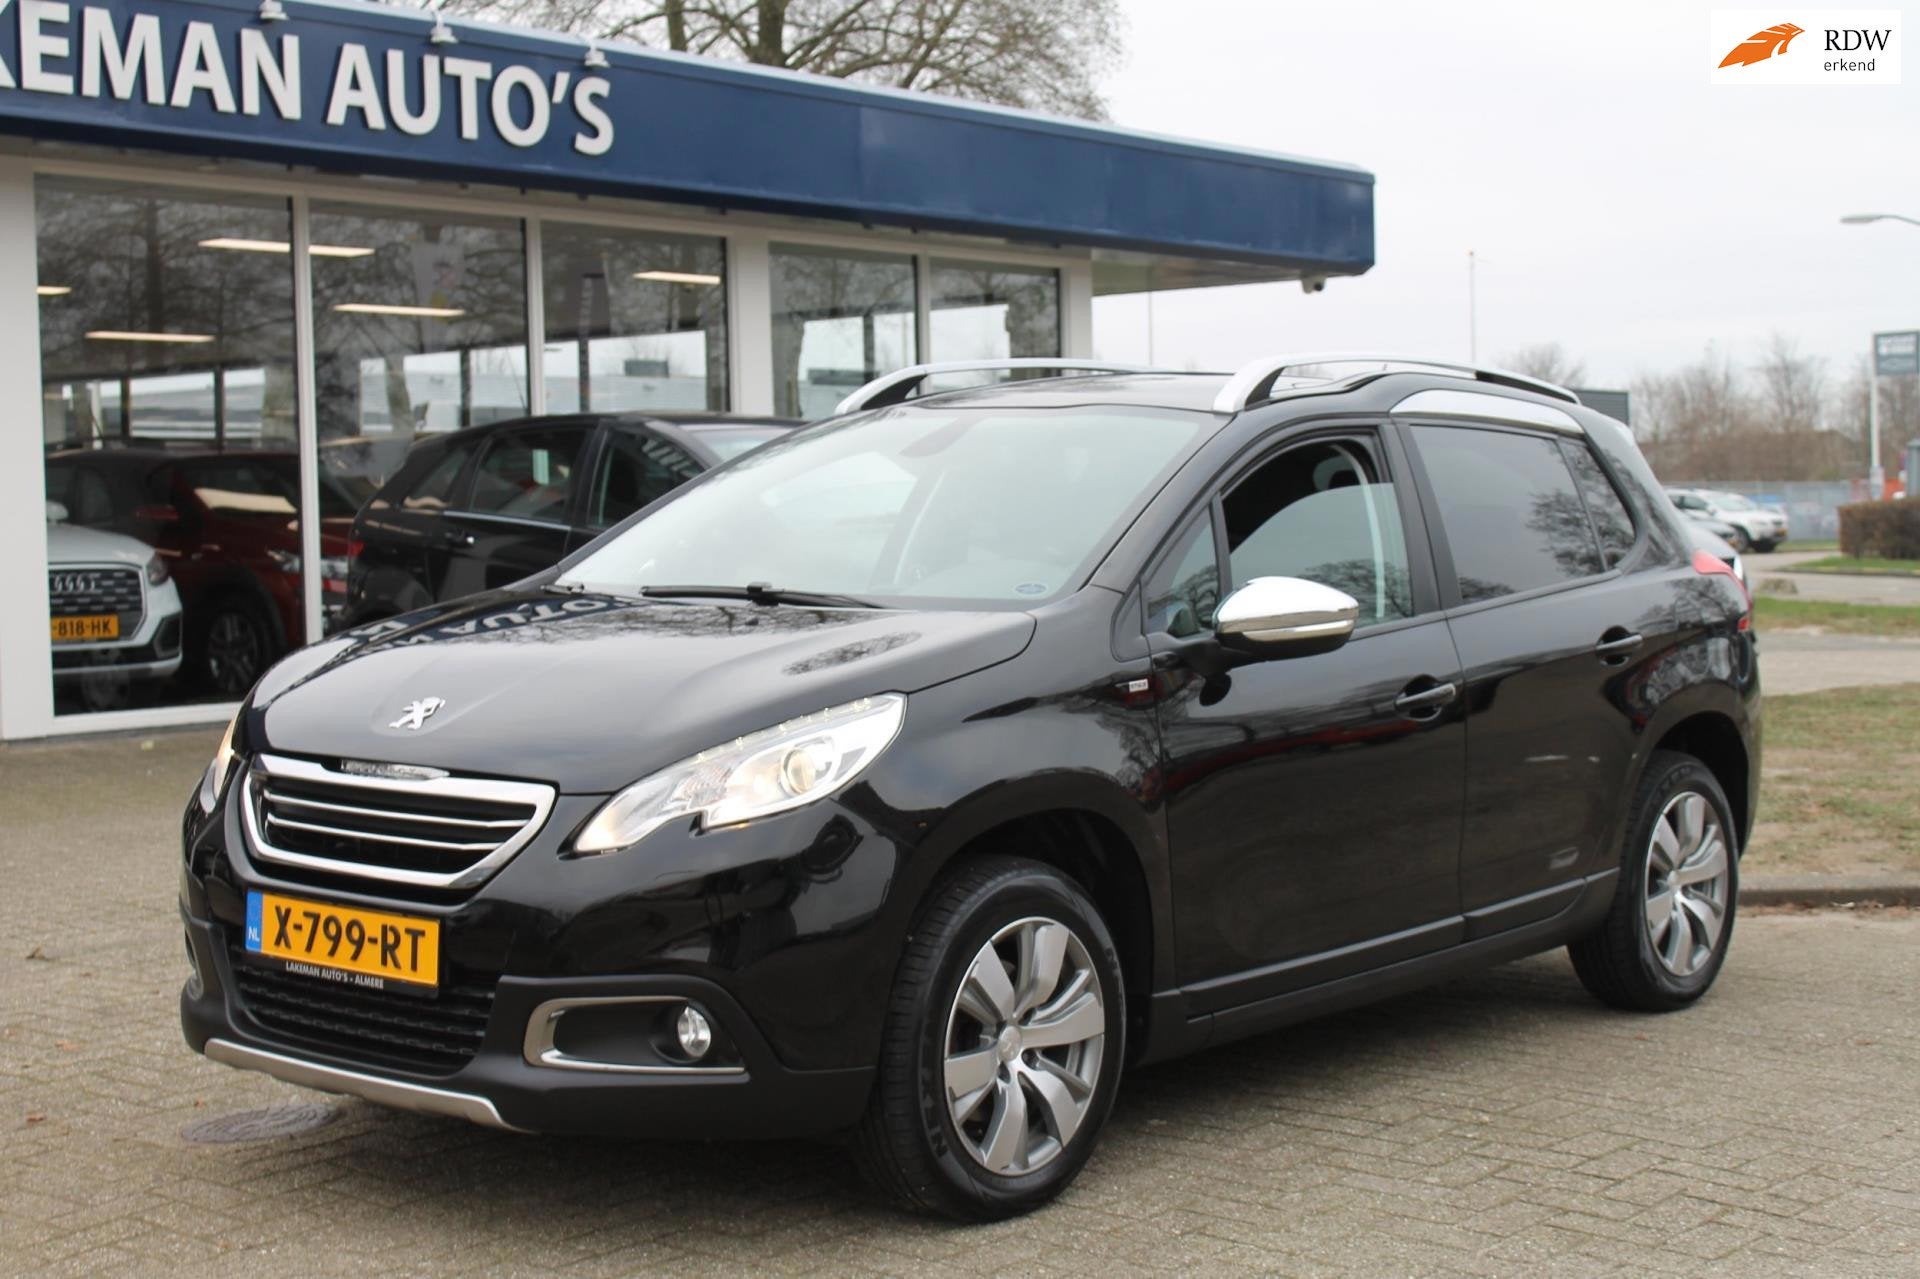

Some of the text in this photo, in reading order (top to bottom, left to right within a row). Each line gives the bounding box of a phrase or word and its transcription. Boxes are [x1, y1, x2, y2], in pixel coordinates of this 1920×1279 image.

[0, 0, 614, 156] EMAN AUTO'S
[273, 904, 426, 973] X-799-RT
[286, 961, 320, 977] LAKEMAN
[321, 968, 348, 983] AUTO'S
[354, 974, 384, 989] ALMERE
